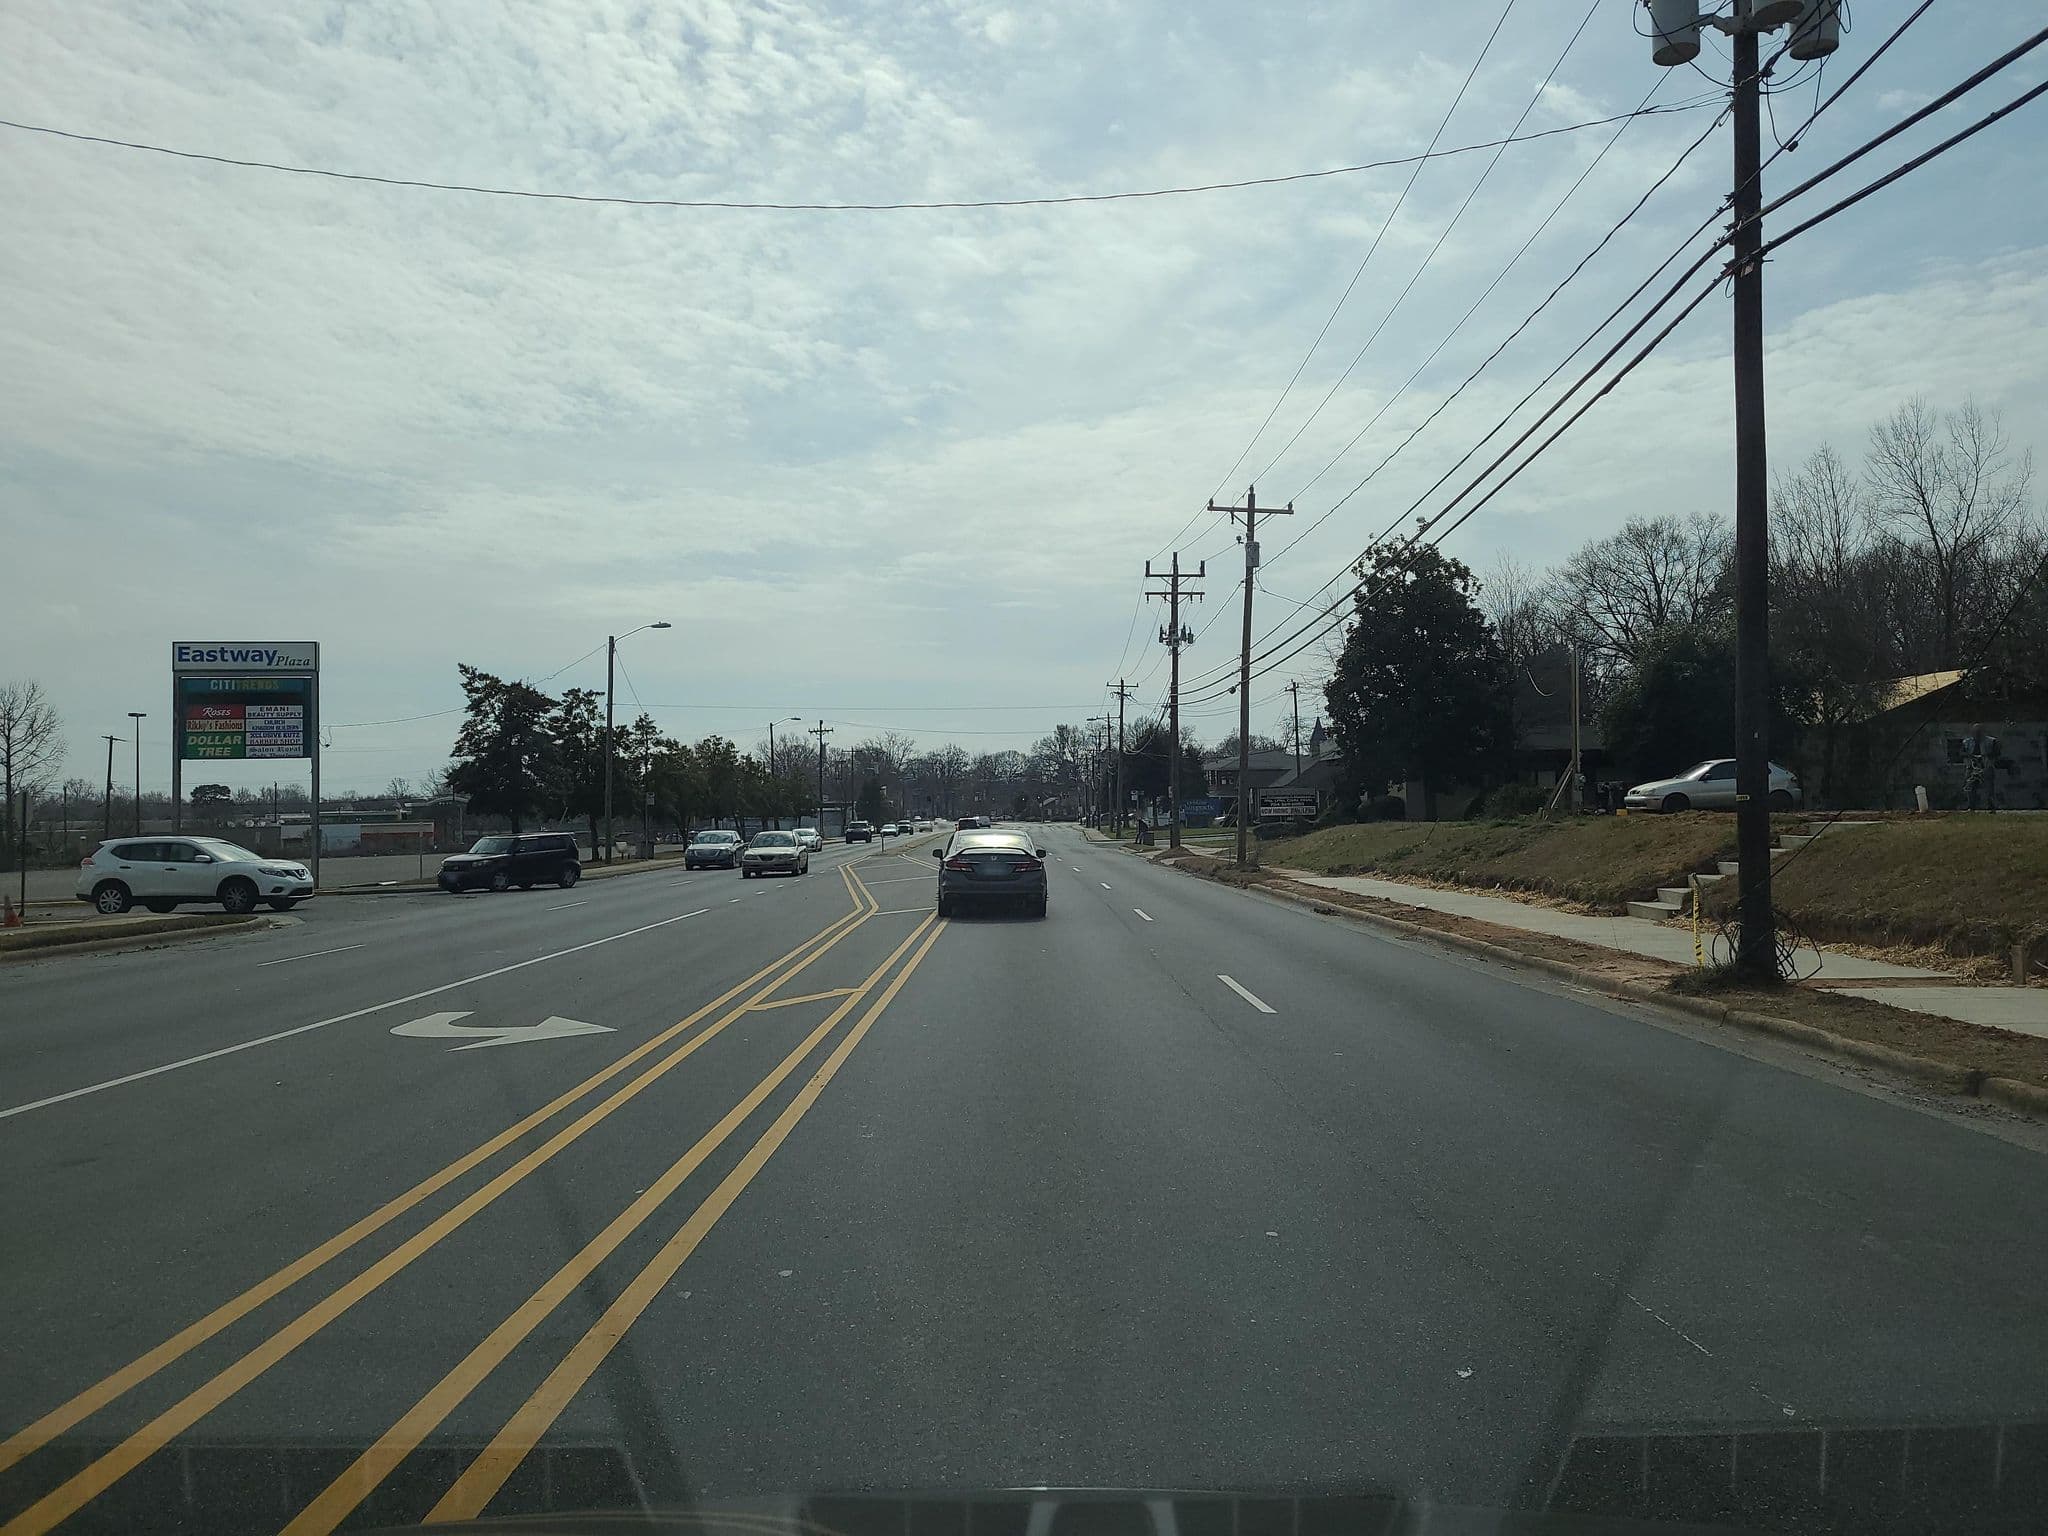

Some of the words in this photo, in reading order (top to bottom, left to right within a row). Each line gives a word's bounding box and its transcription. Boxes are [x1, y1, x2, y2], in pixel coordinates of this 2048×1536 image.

[177, 646, 278, 666] Eastway
[275, 655, 310, 667] Plaza
[214, 719, 243, 730] Fashions
[187, 735, 242, 745] DOLLAR
[197, 747, 231, 756] TREE
